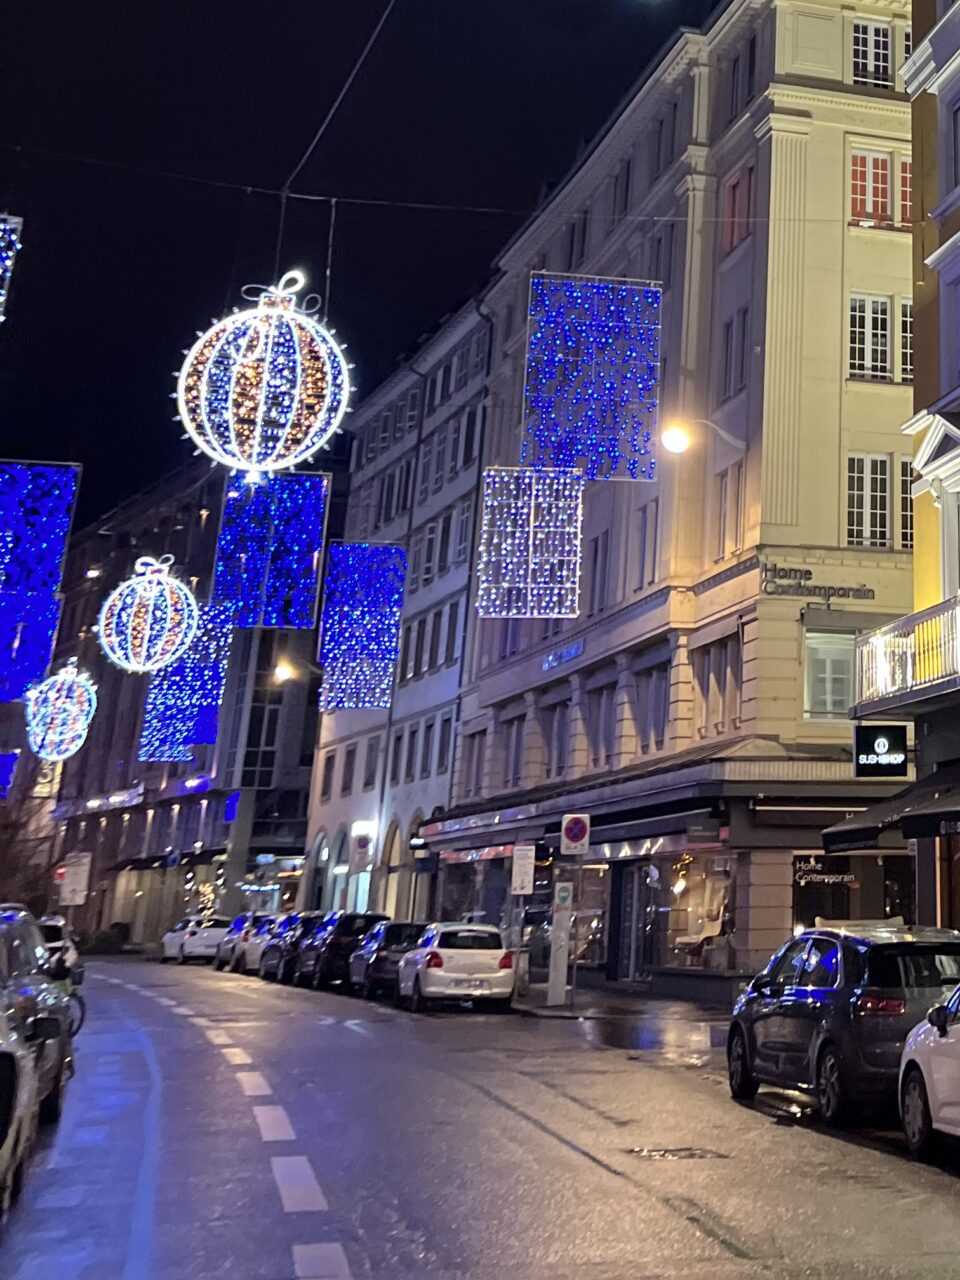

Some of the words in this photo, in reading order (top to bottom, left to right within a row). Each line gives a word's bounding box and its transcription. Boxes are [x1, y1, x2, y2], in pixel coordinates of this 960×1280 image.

[764, 563, 813, 581] Home
[763, 580, 875, 602] Contemporain
[796, 860, 823, 871] Home
[795, 872, 855, 884] Contemporain
